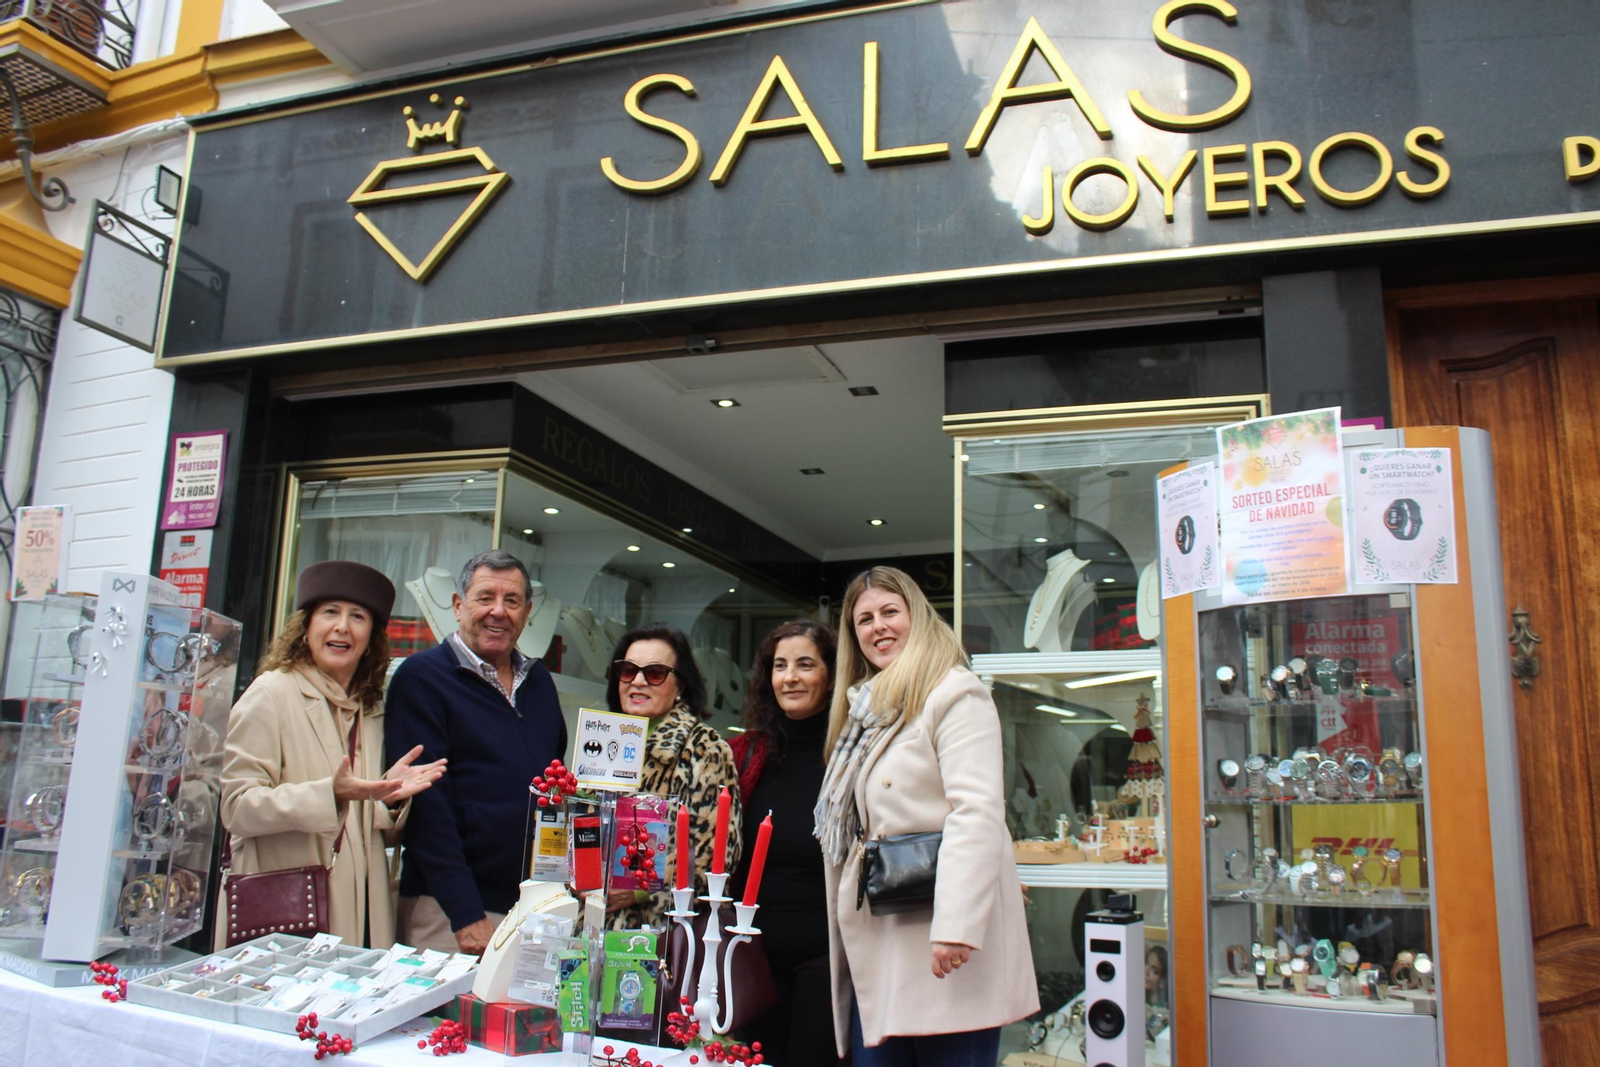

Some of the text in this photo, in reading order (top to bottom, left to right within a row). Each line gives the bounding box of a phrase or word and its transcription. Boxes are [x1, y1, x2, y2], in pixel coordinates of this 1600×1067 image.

[600, 0, 1252, 194] SALAS
[1022, 125, 1451, 235] JOYEROS
[99, 277, 147, 309] SALAS
[194, 442, 220, 452] integra
[178, 460, 218, 472] PROTEGIDO
[1254, 450, 1302, 472] SALAS
[1370, 463, 1404, 472] ¿QUIERES
[541, 417, 652, 502] REGALOS
[667, 484, 725, 542] LISTAS
[174, 484, 216, 498] 24 HORAS
[1232, 482, 1331, 509] SORTEO ESPECIAL
[1249, 501, 1315, 523] DE NAVIDAD
[26, 530, 55, 547] 50%
[170, 547, 202, 564] Direct
[1391, 561, 1422, 570] SALAS
[164, 572, 204, 585] Alarma
[1305, 622, 1385, 639] Alarma
[1305, 640, 1386, 654] conectada
[585, 720, 611, 732] Harry Potter
[1321, 717, 1336, 727] ctt
[624, 747, 636, 759] DC
[4, 954, 39, 978] MADDOX
[81, 968, 128, 984] MK
